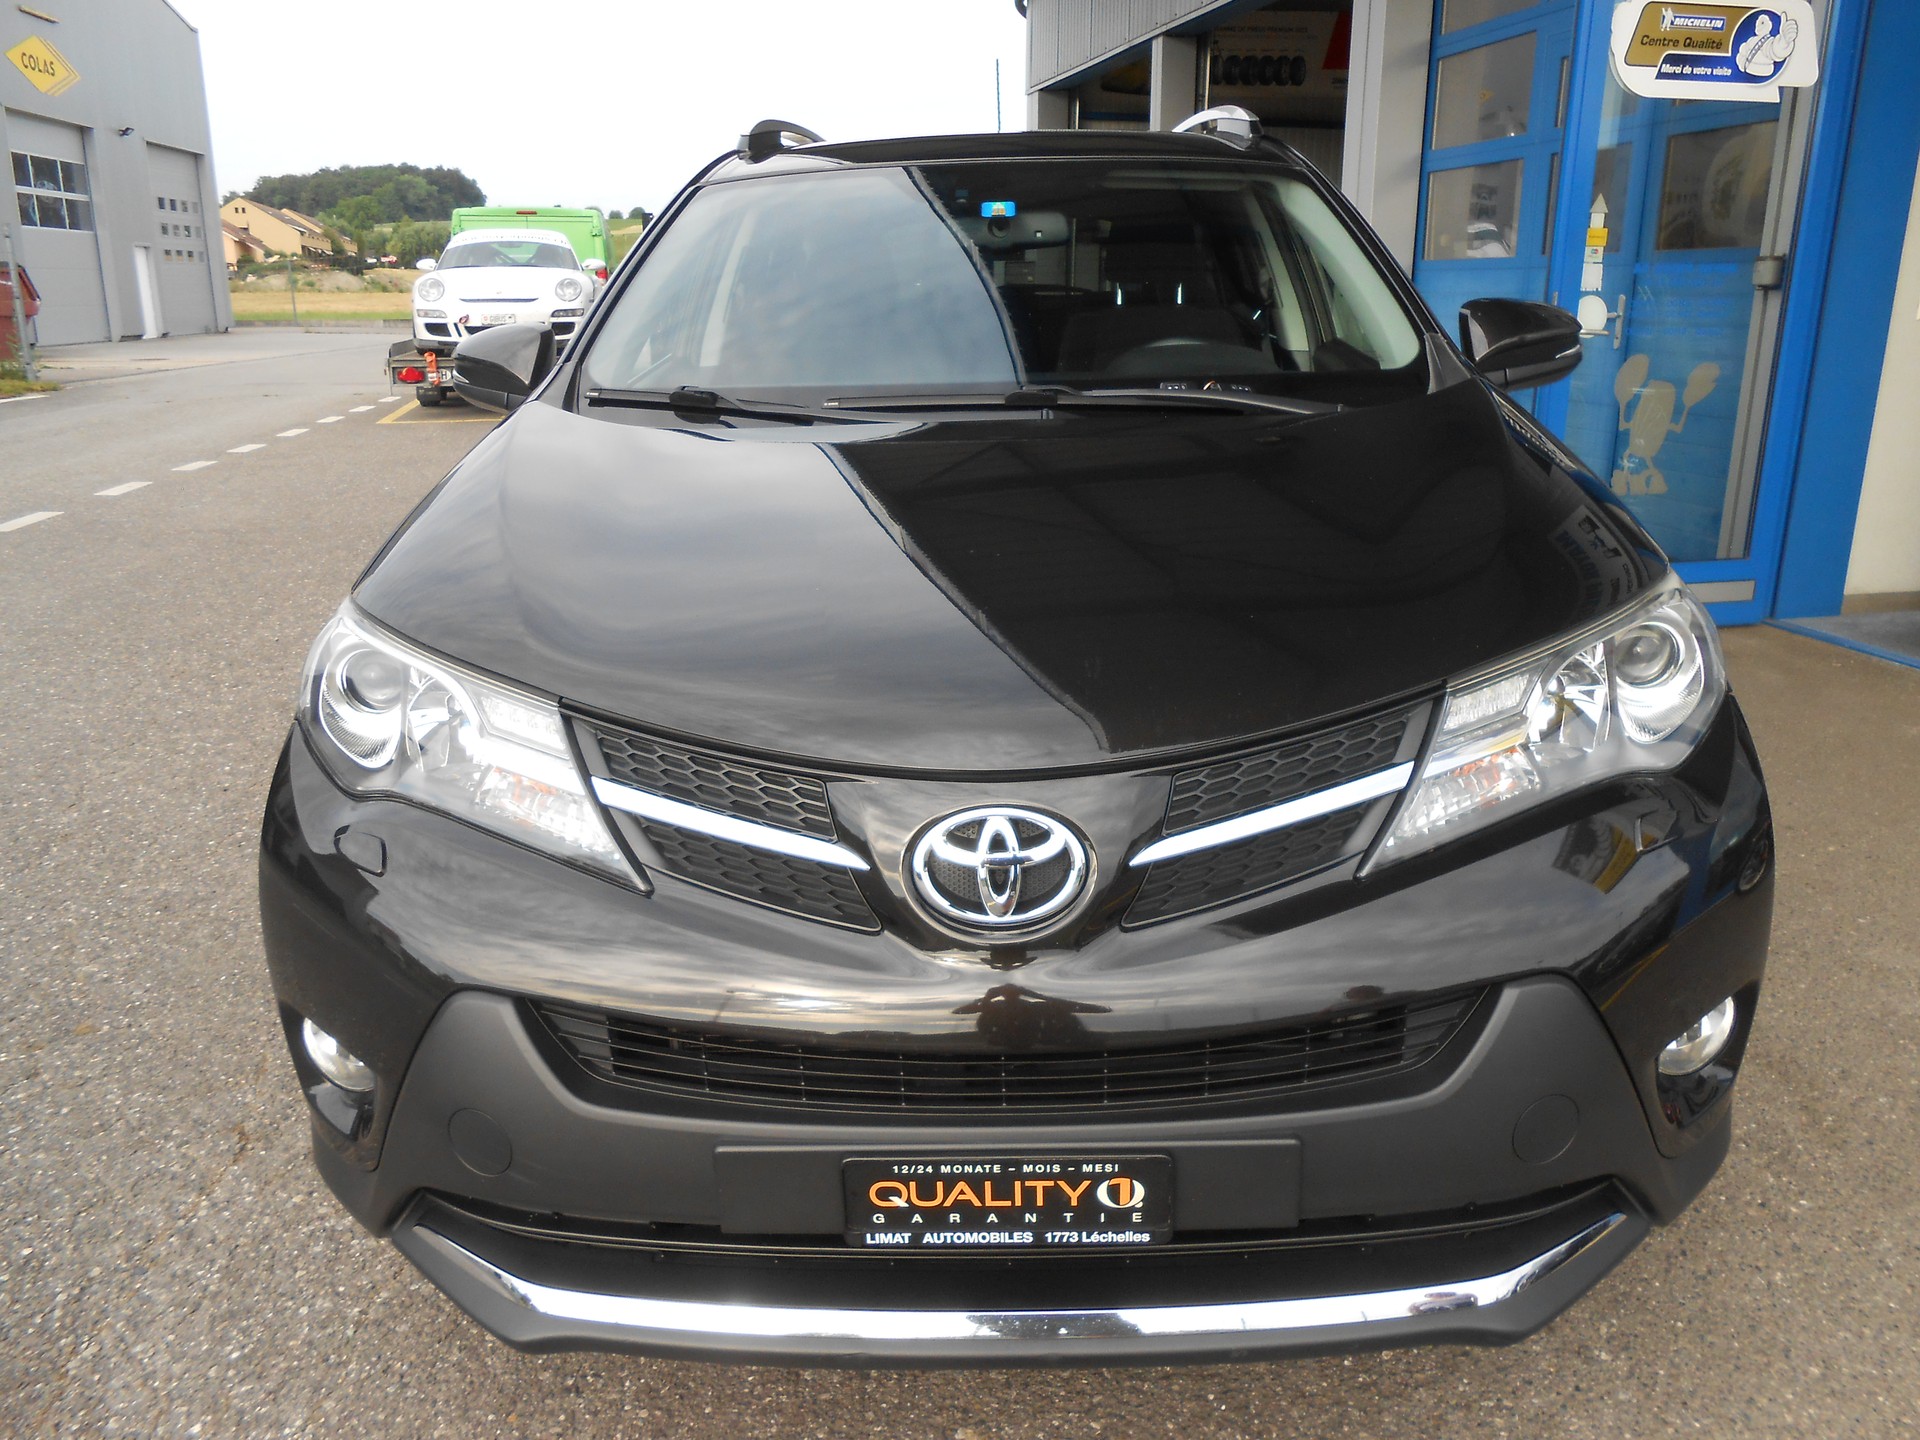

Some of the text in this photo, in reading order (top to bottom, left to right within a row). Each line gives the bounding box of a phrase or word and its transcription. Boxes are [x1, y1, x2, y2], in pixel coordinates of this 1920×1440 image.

[1673, 17, 1723, 29] MICHELIN
[1640, 35, 1723, 50] Centre Qualité
[21, 52, 55, 77] COLAS
[1661, 63, 1732, 76] Merci de votre visite
[892, 1164, 934, 1174] 12/24
[940, 1164, 1002, 1174] MONATE
[1023, 1164, 1061, 1173] MOIS
[1082, 1164, 1119, 1173] MESI
[868, 1179, 1092, 1208] QUALITY
[866, 1230, 1151, 1244] LIMAT AUTOMOBILES 1773 Léchelles
